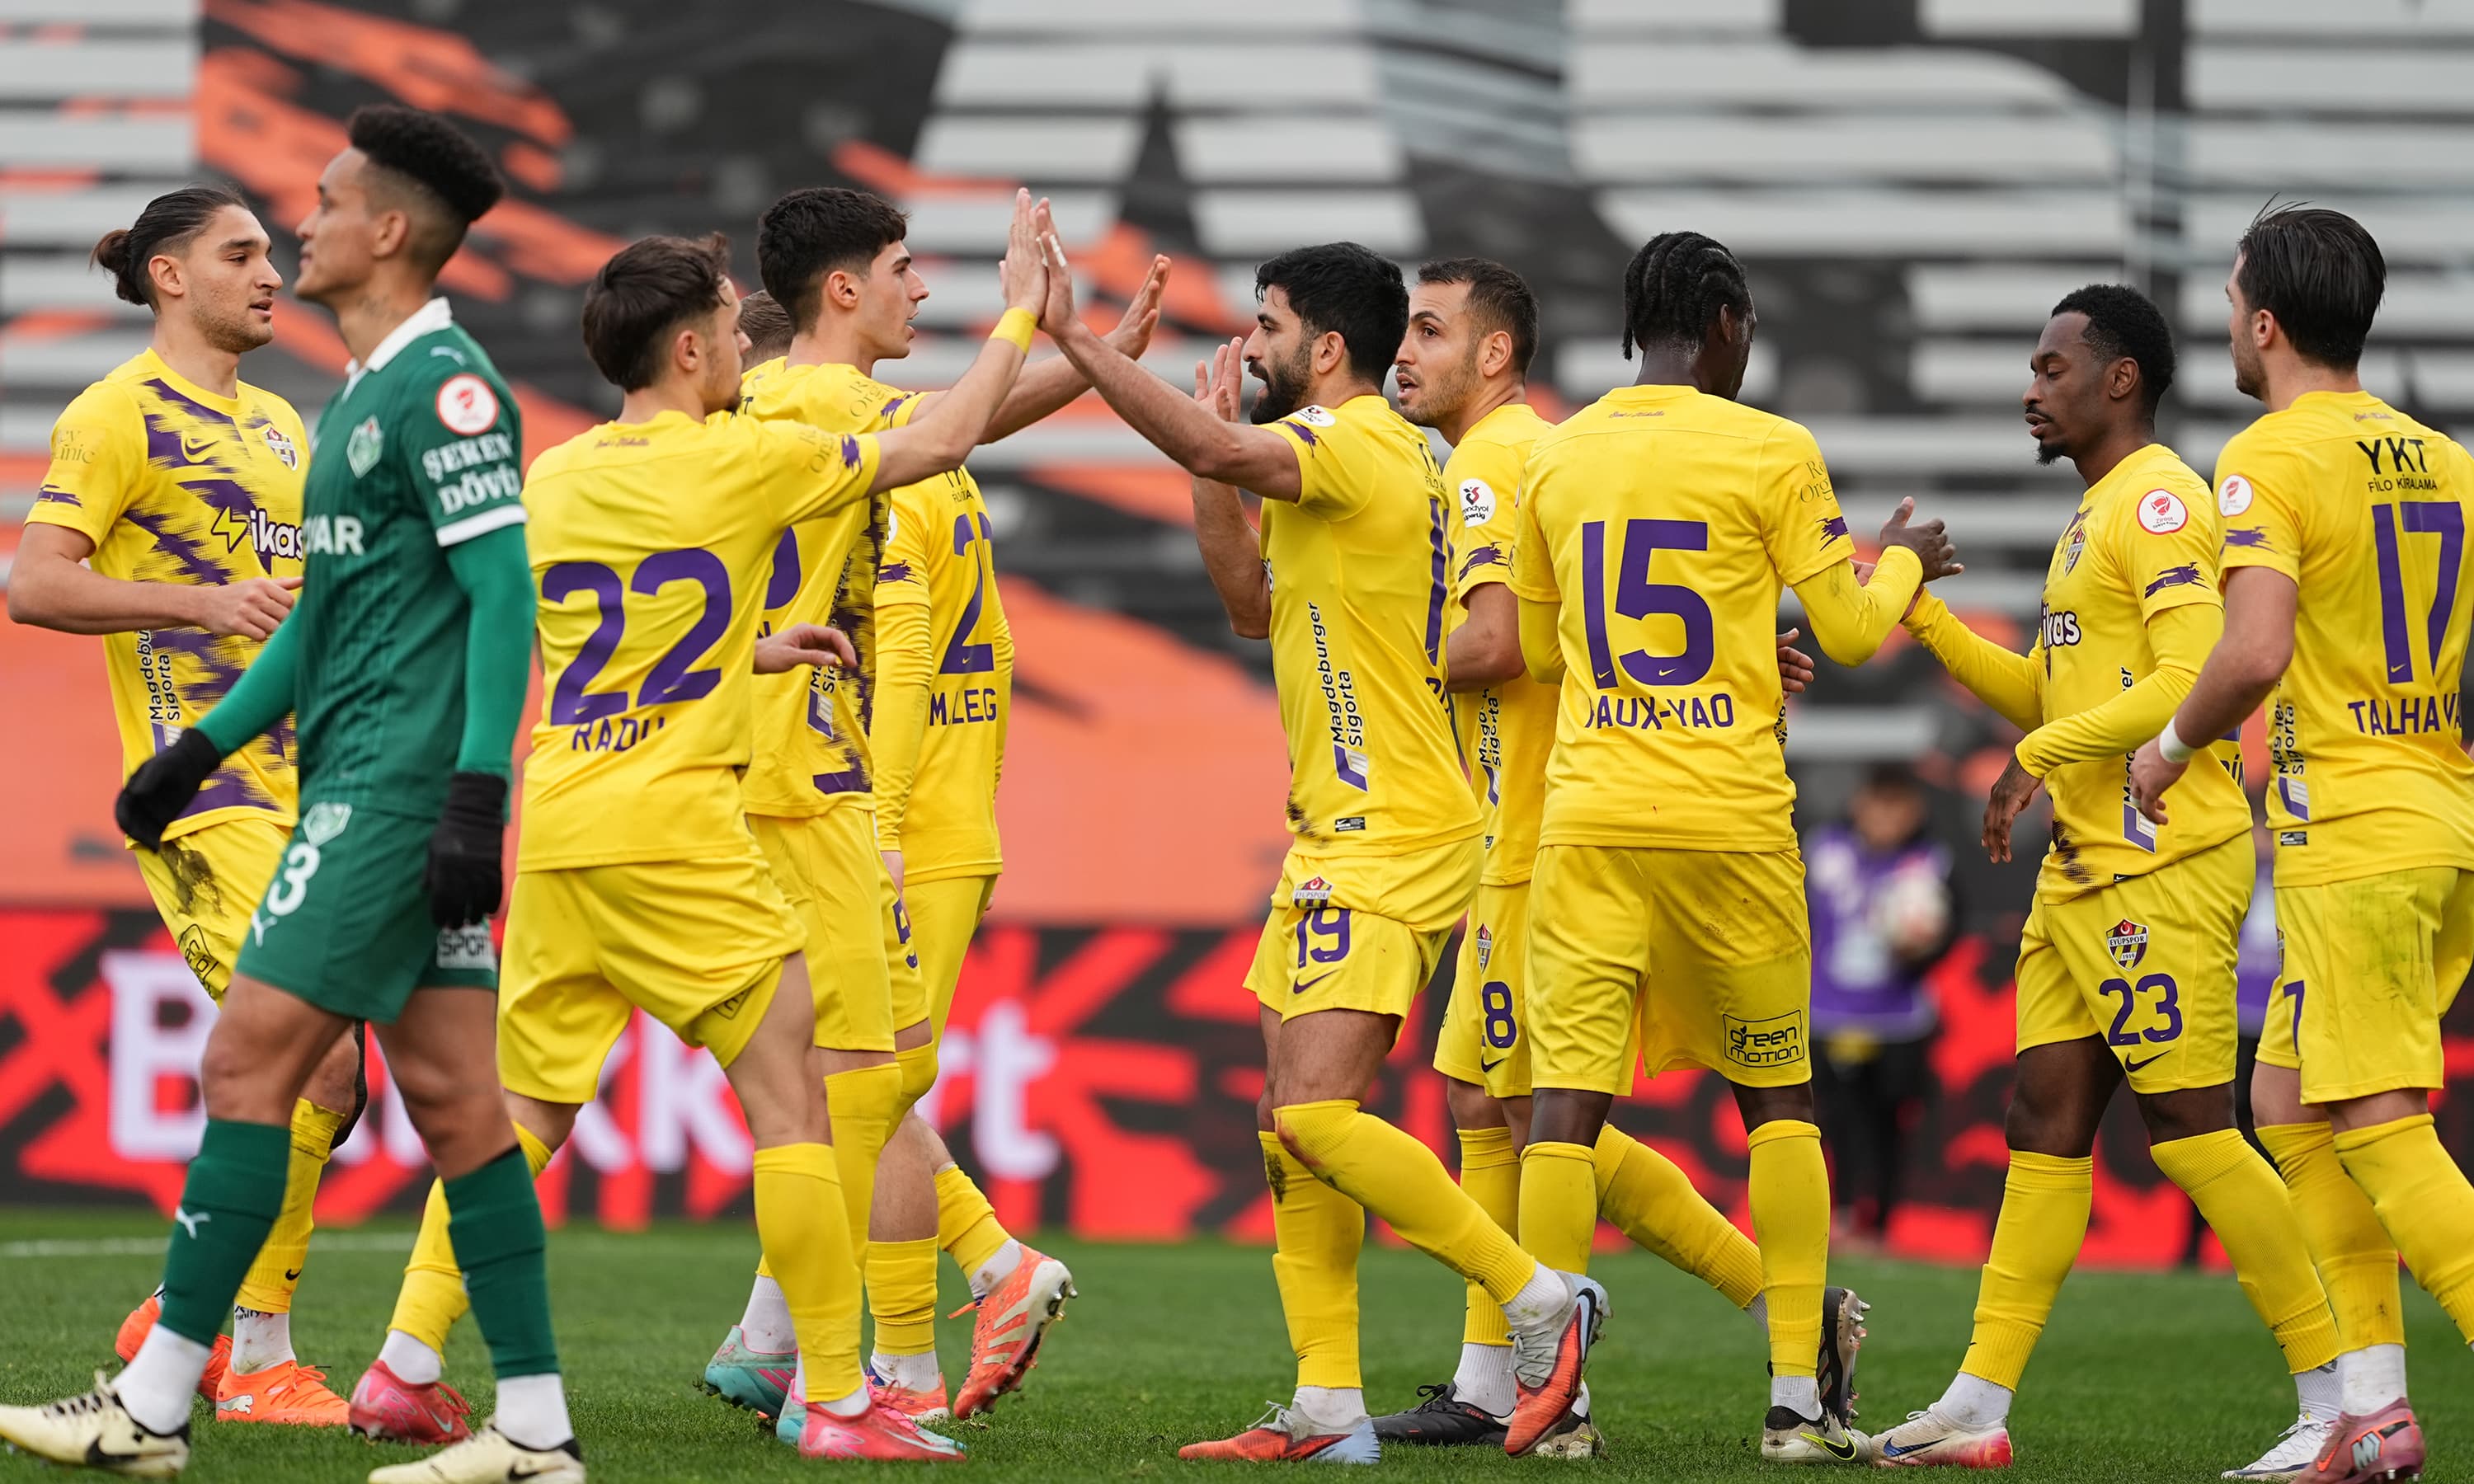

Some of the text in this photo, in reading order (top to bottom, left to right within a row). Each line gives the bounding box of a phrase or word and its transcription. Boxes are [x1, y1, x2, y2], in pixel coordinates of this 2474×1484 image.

[2355, 437, 2427, 475] YKT
[2368, 474, 2438, 492] FİLO KİRALAMA
[1582, 519, 1714, 689] 15
[2372, 501, 2465, 683] 17
[541, 547, 732, 727] 22
[2042, 606, 2081, 649] ikas
[158, 655, 181, 721] Sigorta
[1308, 601, 1344, 744] Magdeburger
[1338, 670, 1364, 747] Sigorta
[266, 842, 321, 917] 3
[1296, 906, 1351, 969] 19
[2109, 936, 2146, 947] EYÜPSPOR
[2099, 973, 2184, 1046] 23
[1465, 1408, 1484, 1421] COPA
